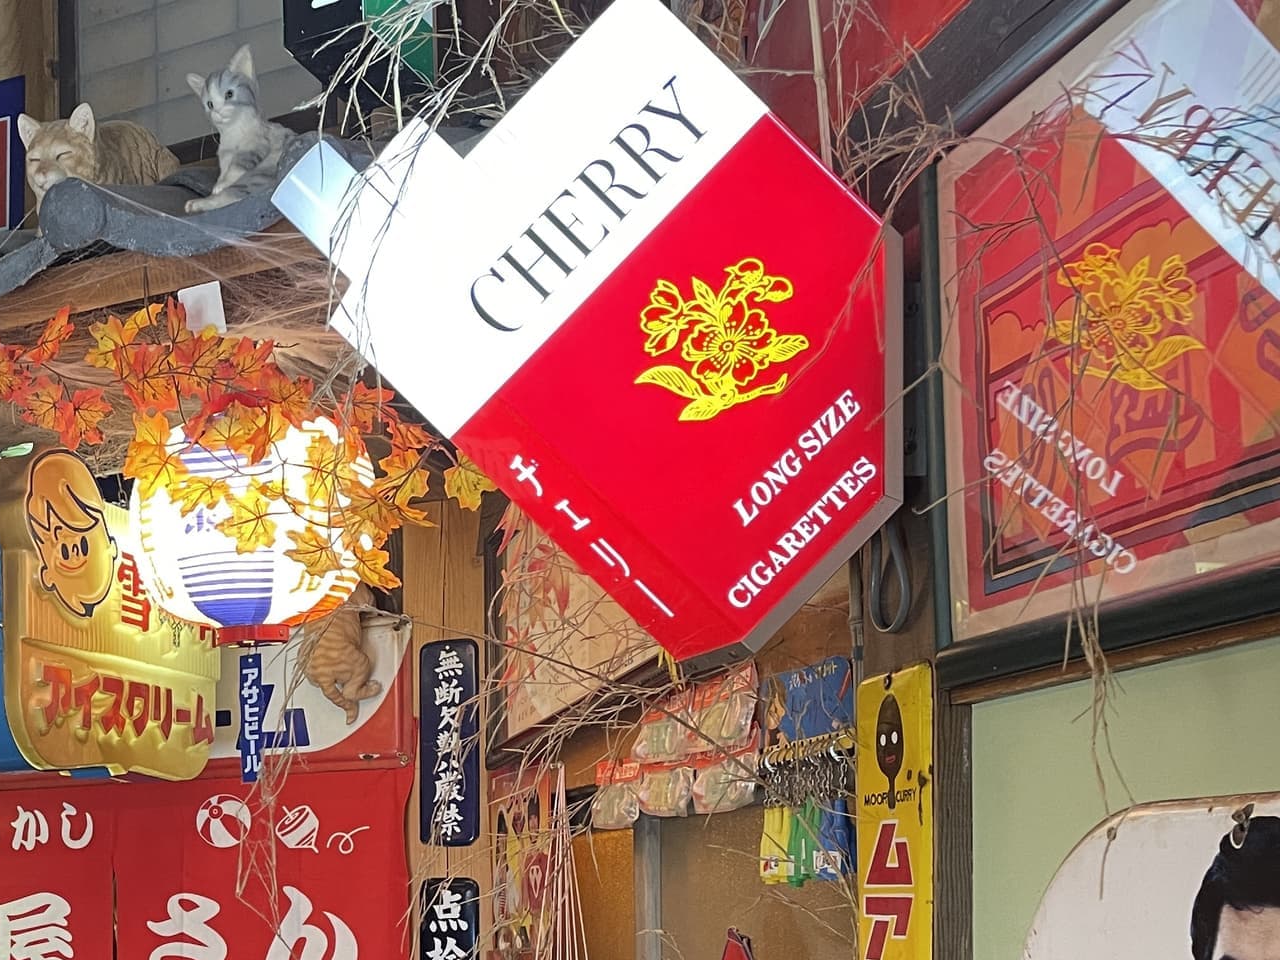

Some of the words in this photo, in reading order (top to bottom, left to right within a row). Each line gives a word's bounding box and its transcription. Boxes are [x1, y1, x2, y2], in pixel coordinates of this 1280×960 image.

[470, 74, 708, 333] CHERRY
[733, 453, 802, 527] LONG
[796, 388, 863, 461] SIZE
[509, 454, 675, 619] チェリー
[727, 455, 878, 610] CIGARETTES
[41, 664, 215, 745] アイスクリーム
[241, 668, 261, 773] アサヒビール
